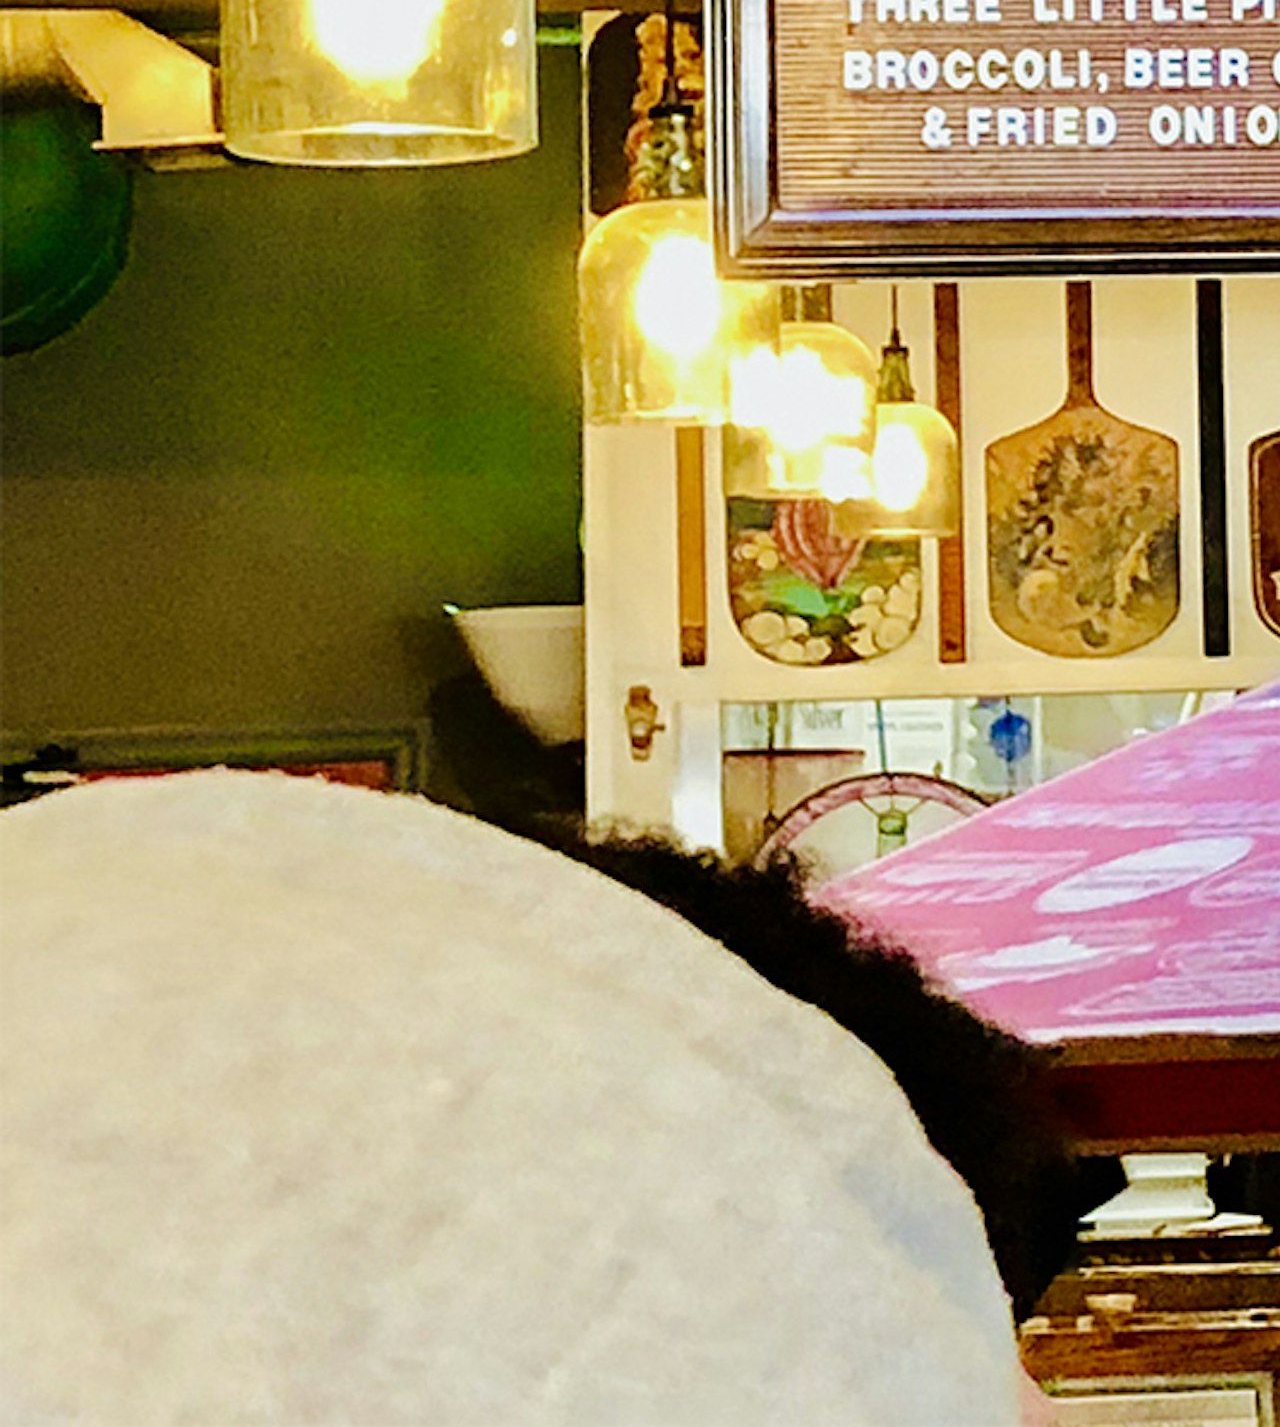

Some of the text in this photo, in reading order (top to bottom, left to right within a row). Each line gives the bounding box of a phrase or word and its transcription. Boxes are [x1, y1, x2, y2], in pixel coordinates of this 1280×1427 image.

[843, 48, 1109, 93] BROCCOLI,
[1124, 48, 1249, 88] BEER
[921, 106, 953, 148] &
[967, 106, 1117, 147] FRIED
